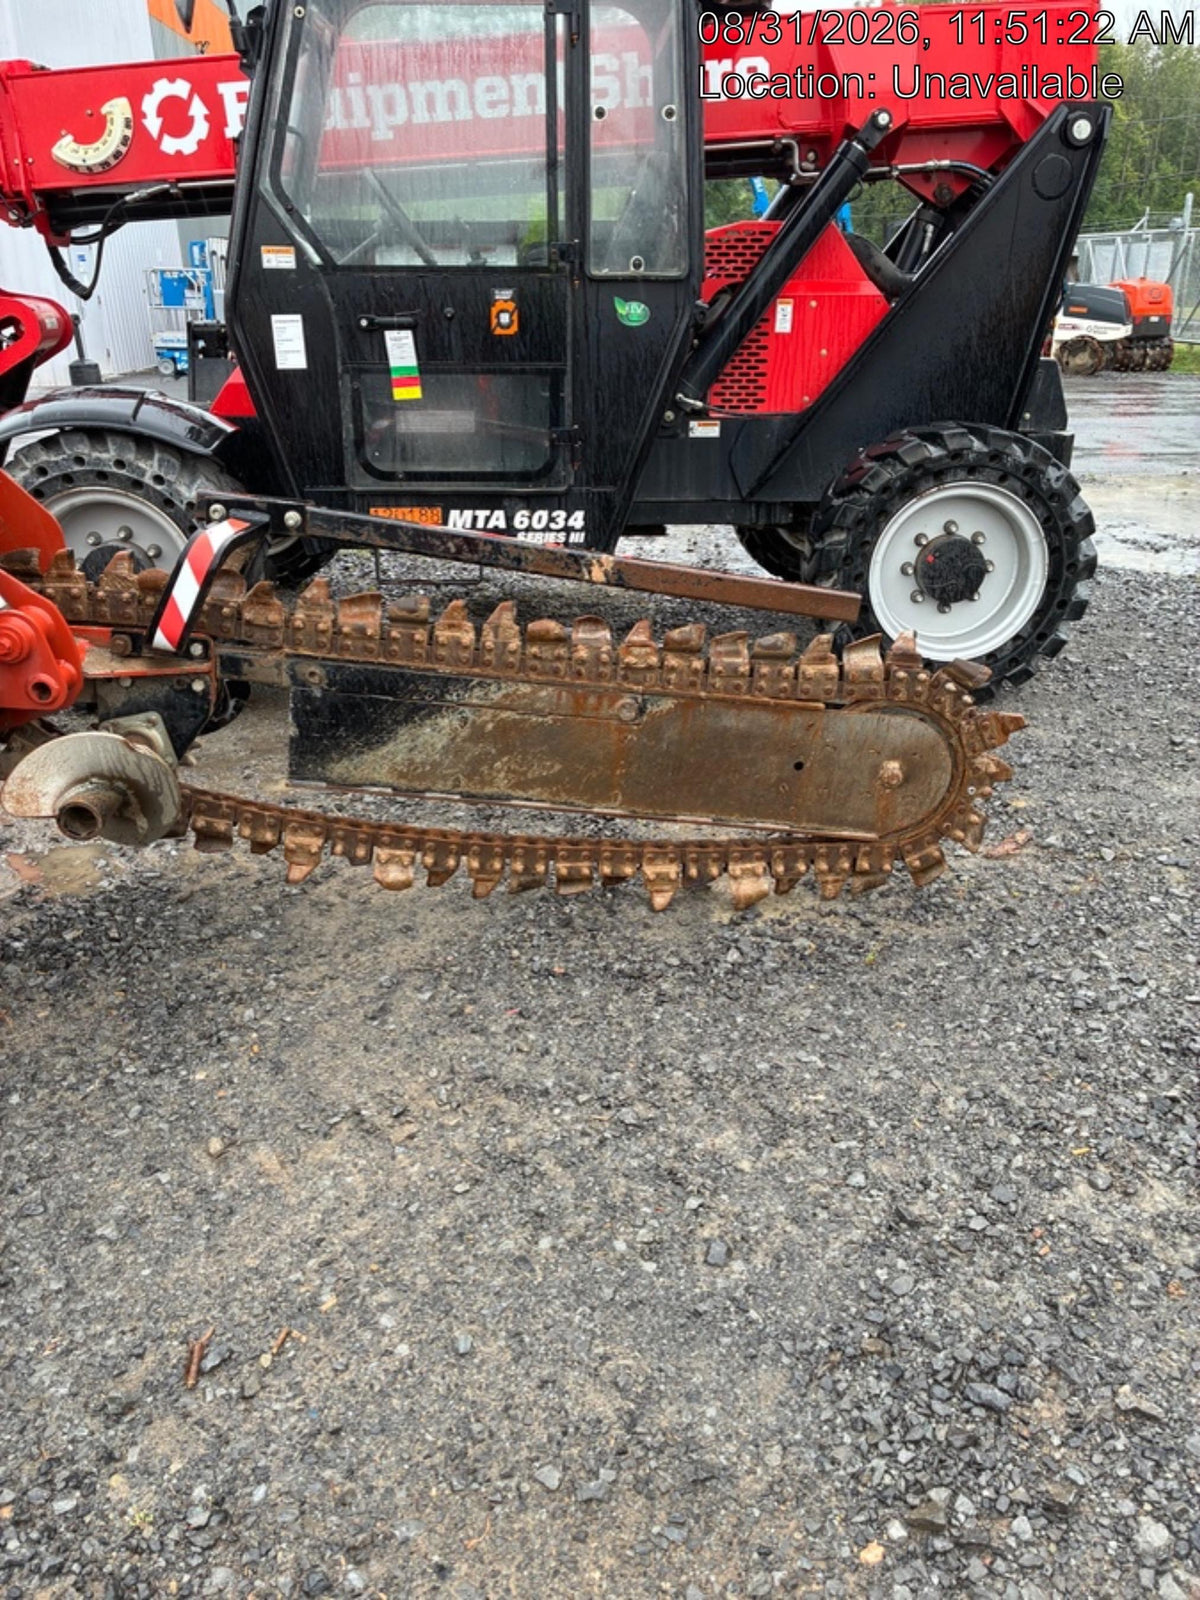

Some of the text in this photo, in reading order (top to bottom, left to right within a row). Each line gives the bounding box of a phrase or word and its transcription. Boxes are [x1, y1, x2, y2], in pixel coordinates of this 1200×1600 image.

[448, 510, 585, 530] MTA 6034
[517, 531, 567, 544] SERIES
